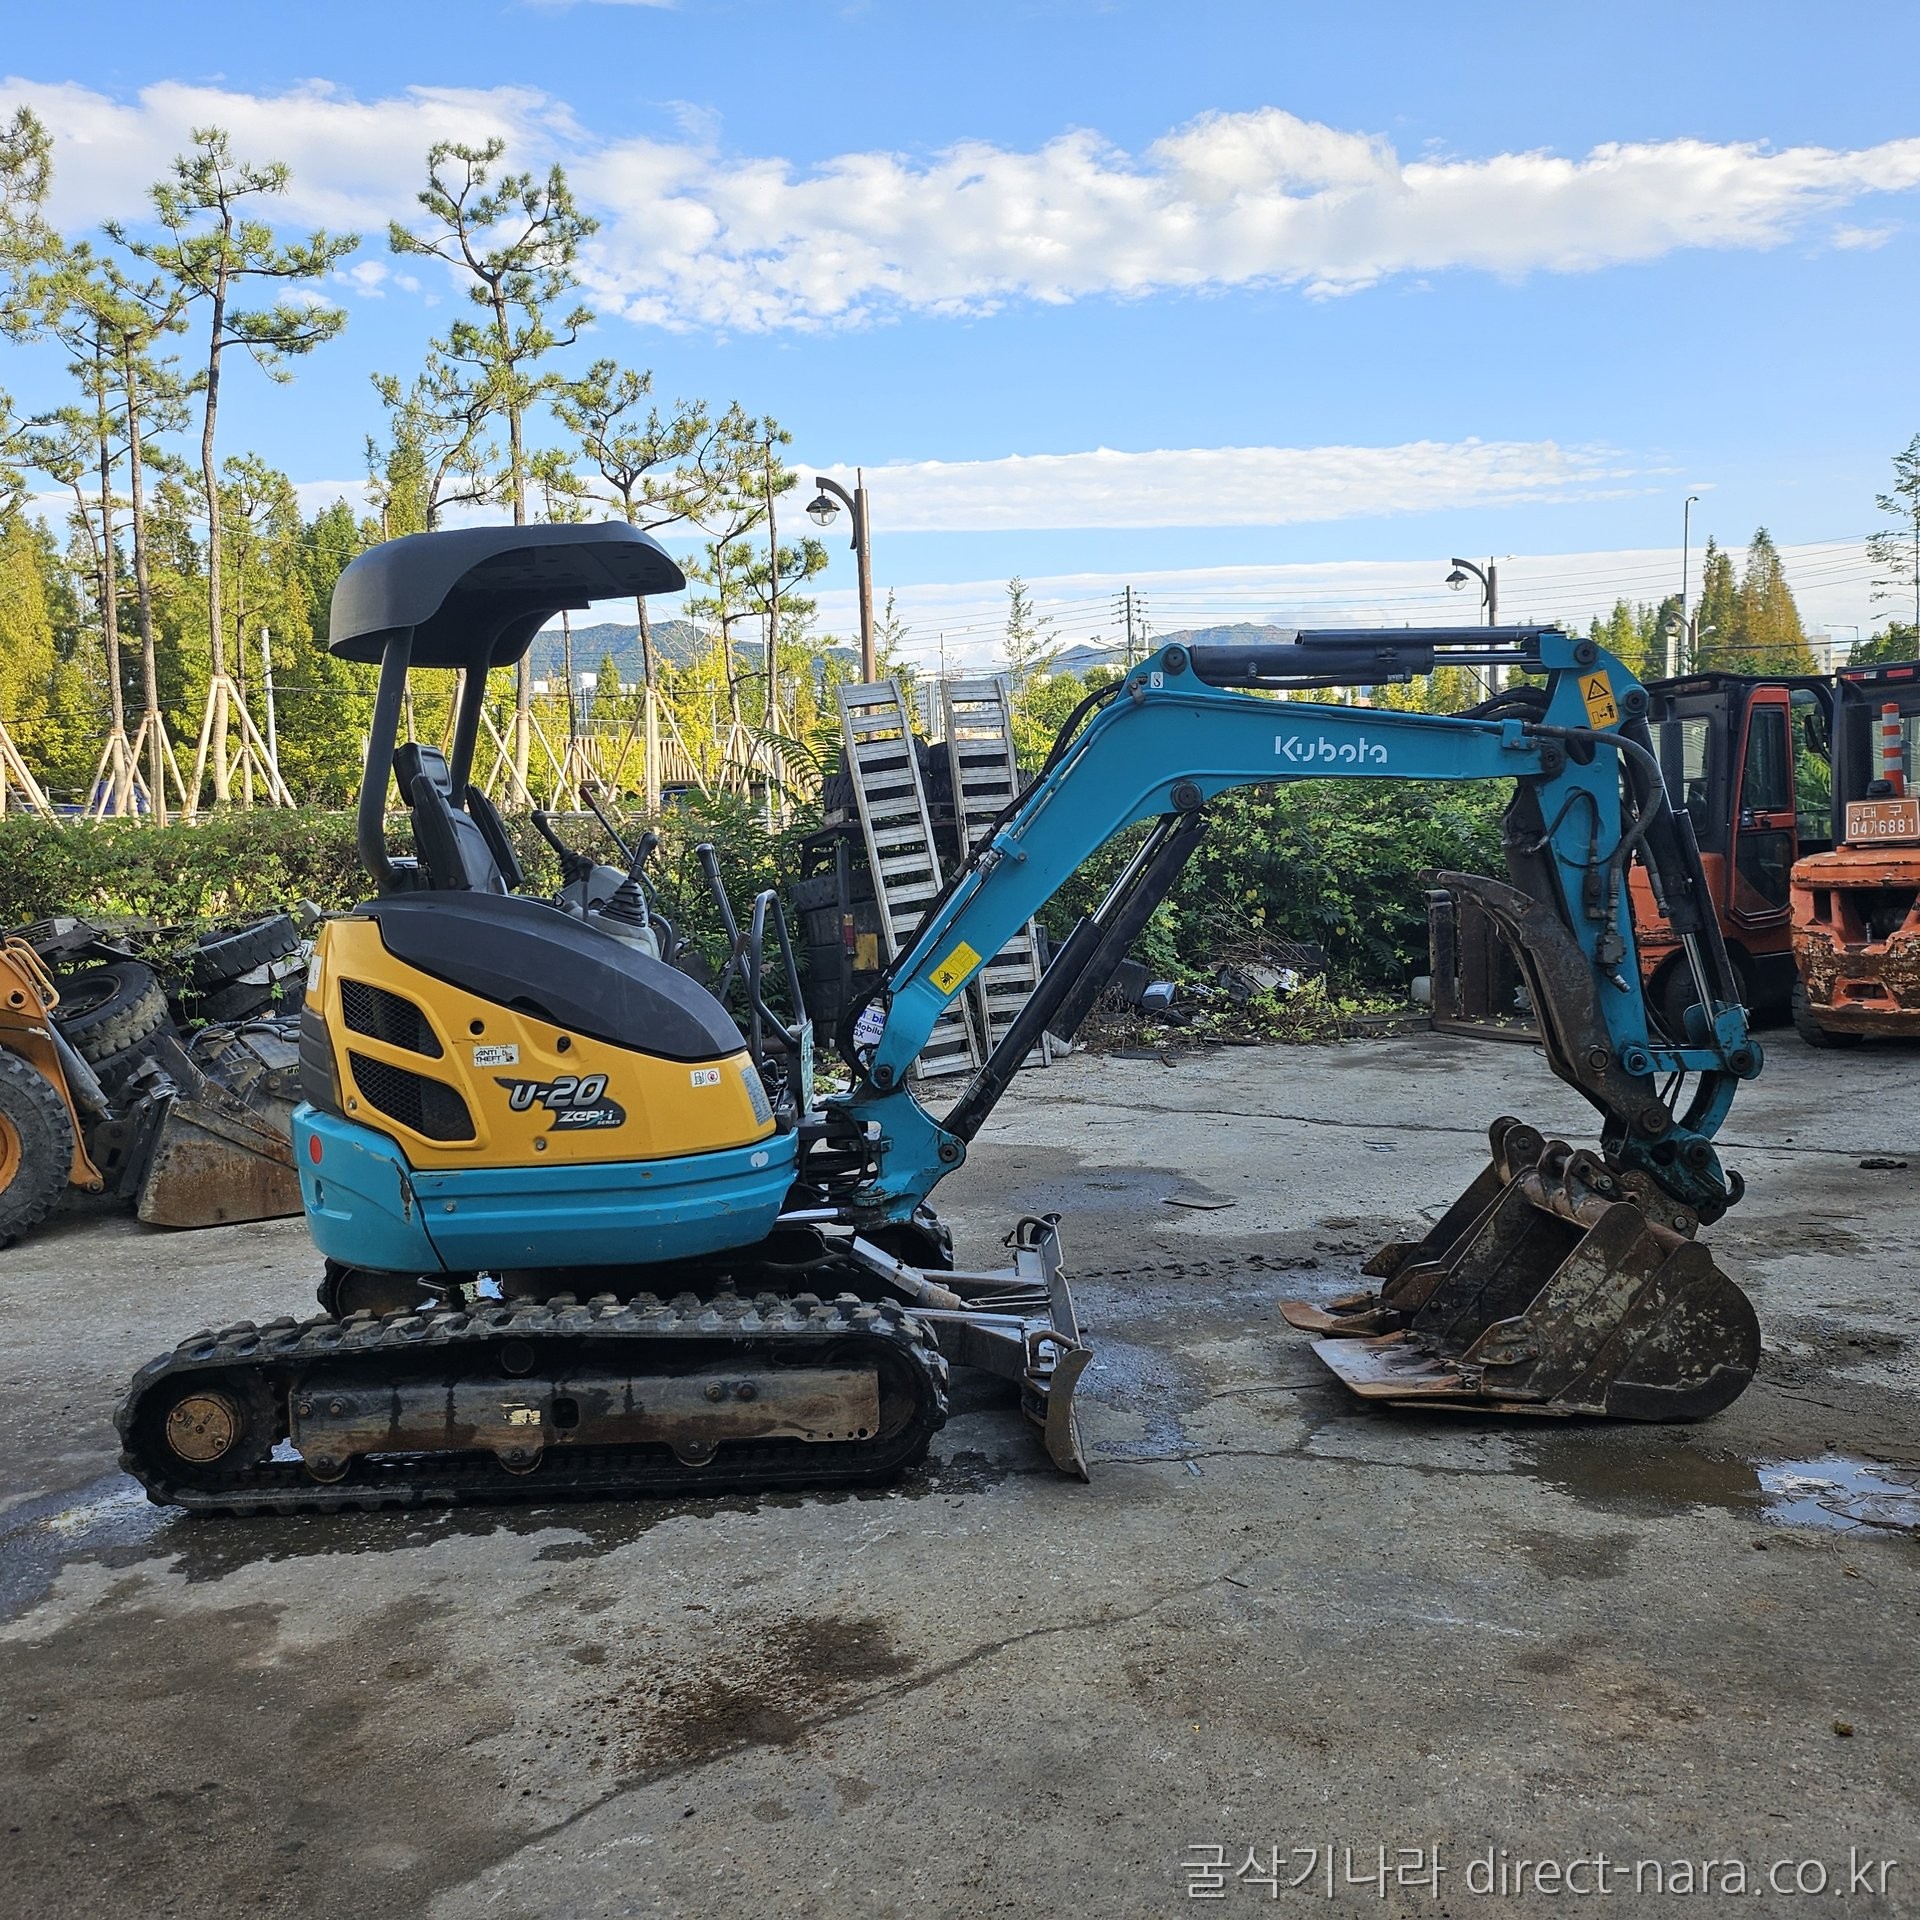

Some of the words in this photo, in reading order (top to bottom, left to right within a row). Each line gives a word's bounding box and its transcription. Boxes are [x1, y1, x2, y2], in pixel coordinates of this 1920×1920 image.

[1274, 735, 1388, 763] Kubota
[1863, 805, 1902, 818] 대구
[1851, 818, 1914, 836] 04가6881
[510, 1074, 608, 1110] U-20
